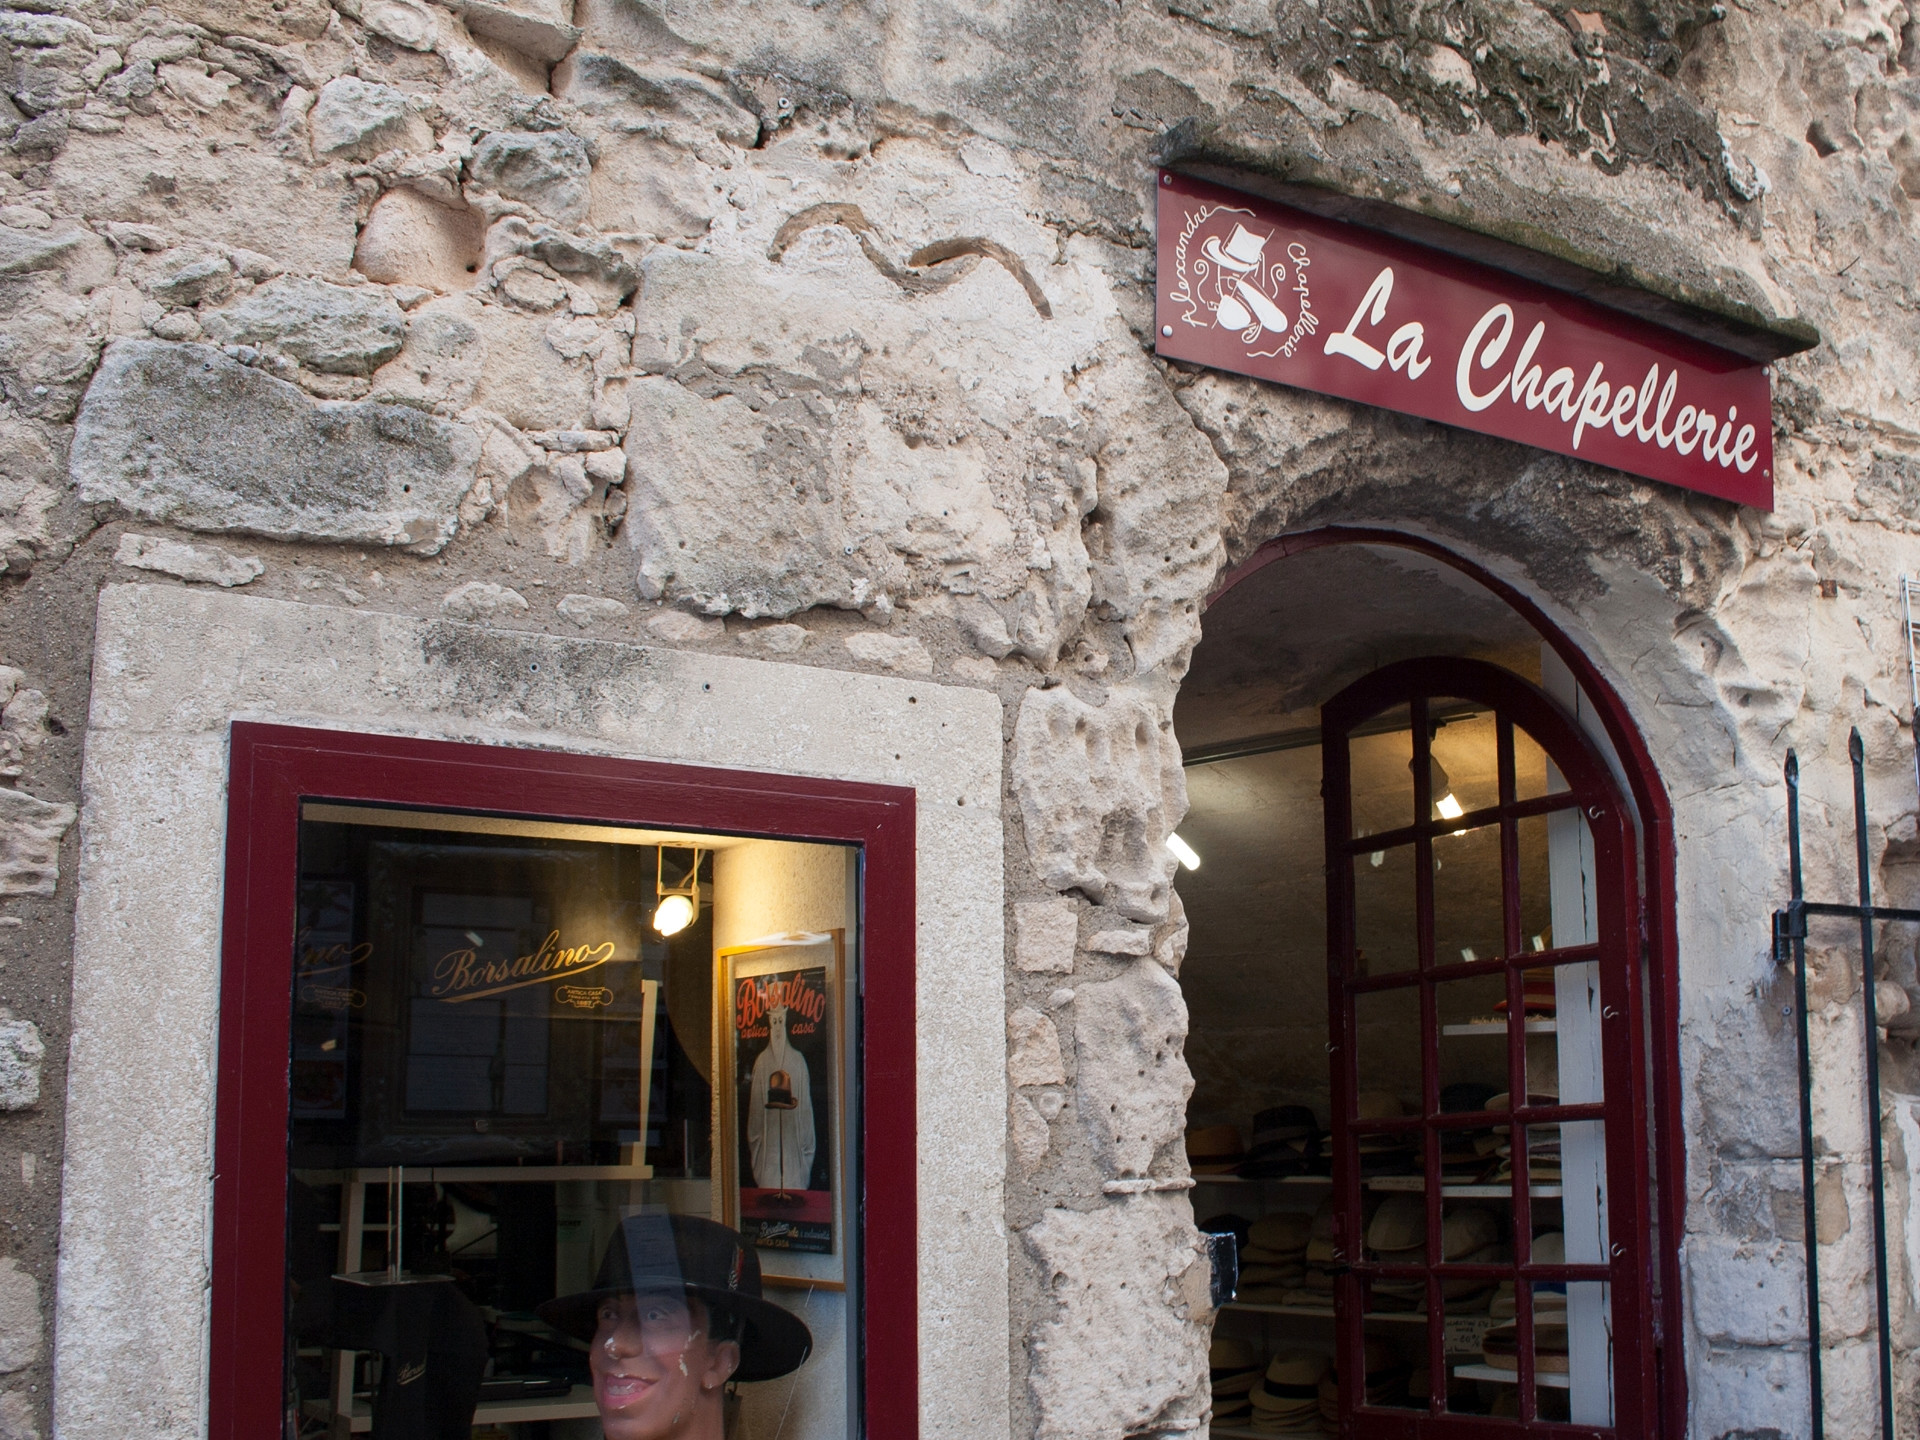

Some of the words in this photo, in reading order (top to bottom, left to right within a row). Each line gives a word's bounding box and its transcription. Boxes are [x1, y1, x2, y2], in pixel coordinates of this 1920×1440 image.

[1169, 204, 1218, 328] Alexandre
[1279, 241, 1320, 358] Chapellerie
[1323, 266, 1432, 380] La
[1455, 302, 1759, 474] Chapellerie
[431, 928, 615, 1002] Borsalino
[736, 972, 825, 1029] Borsalino
